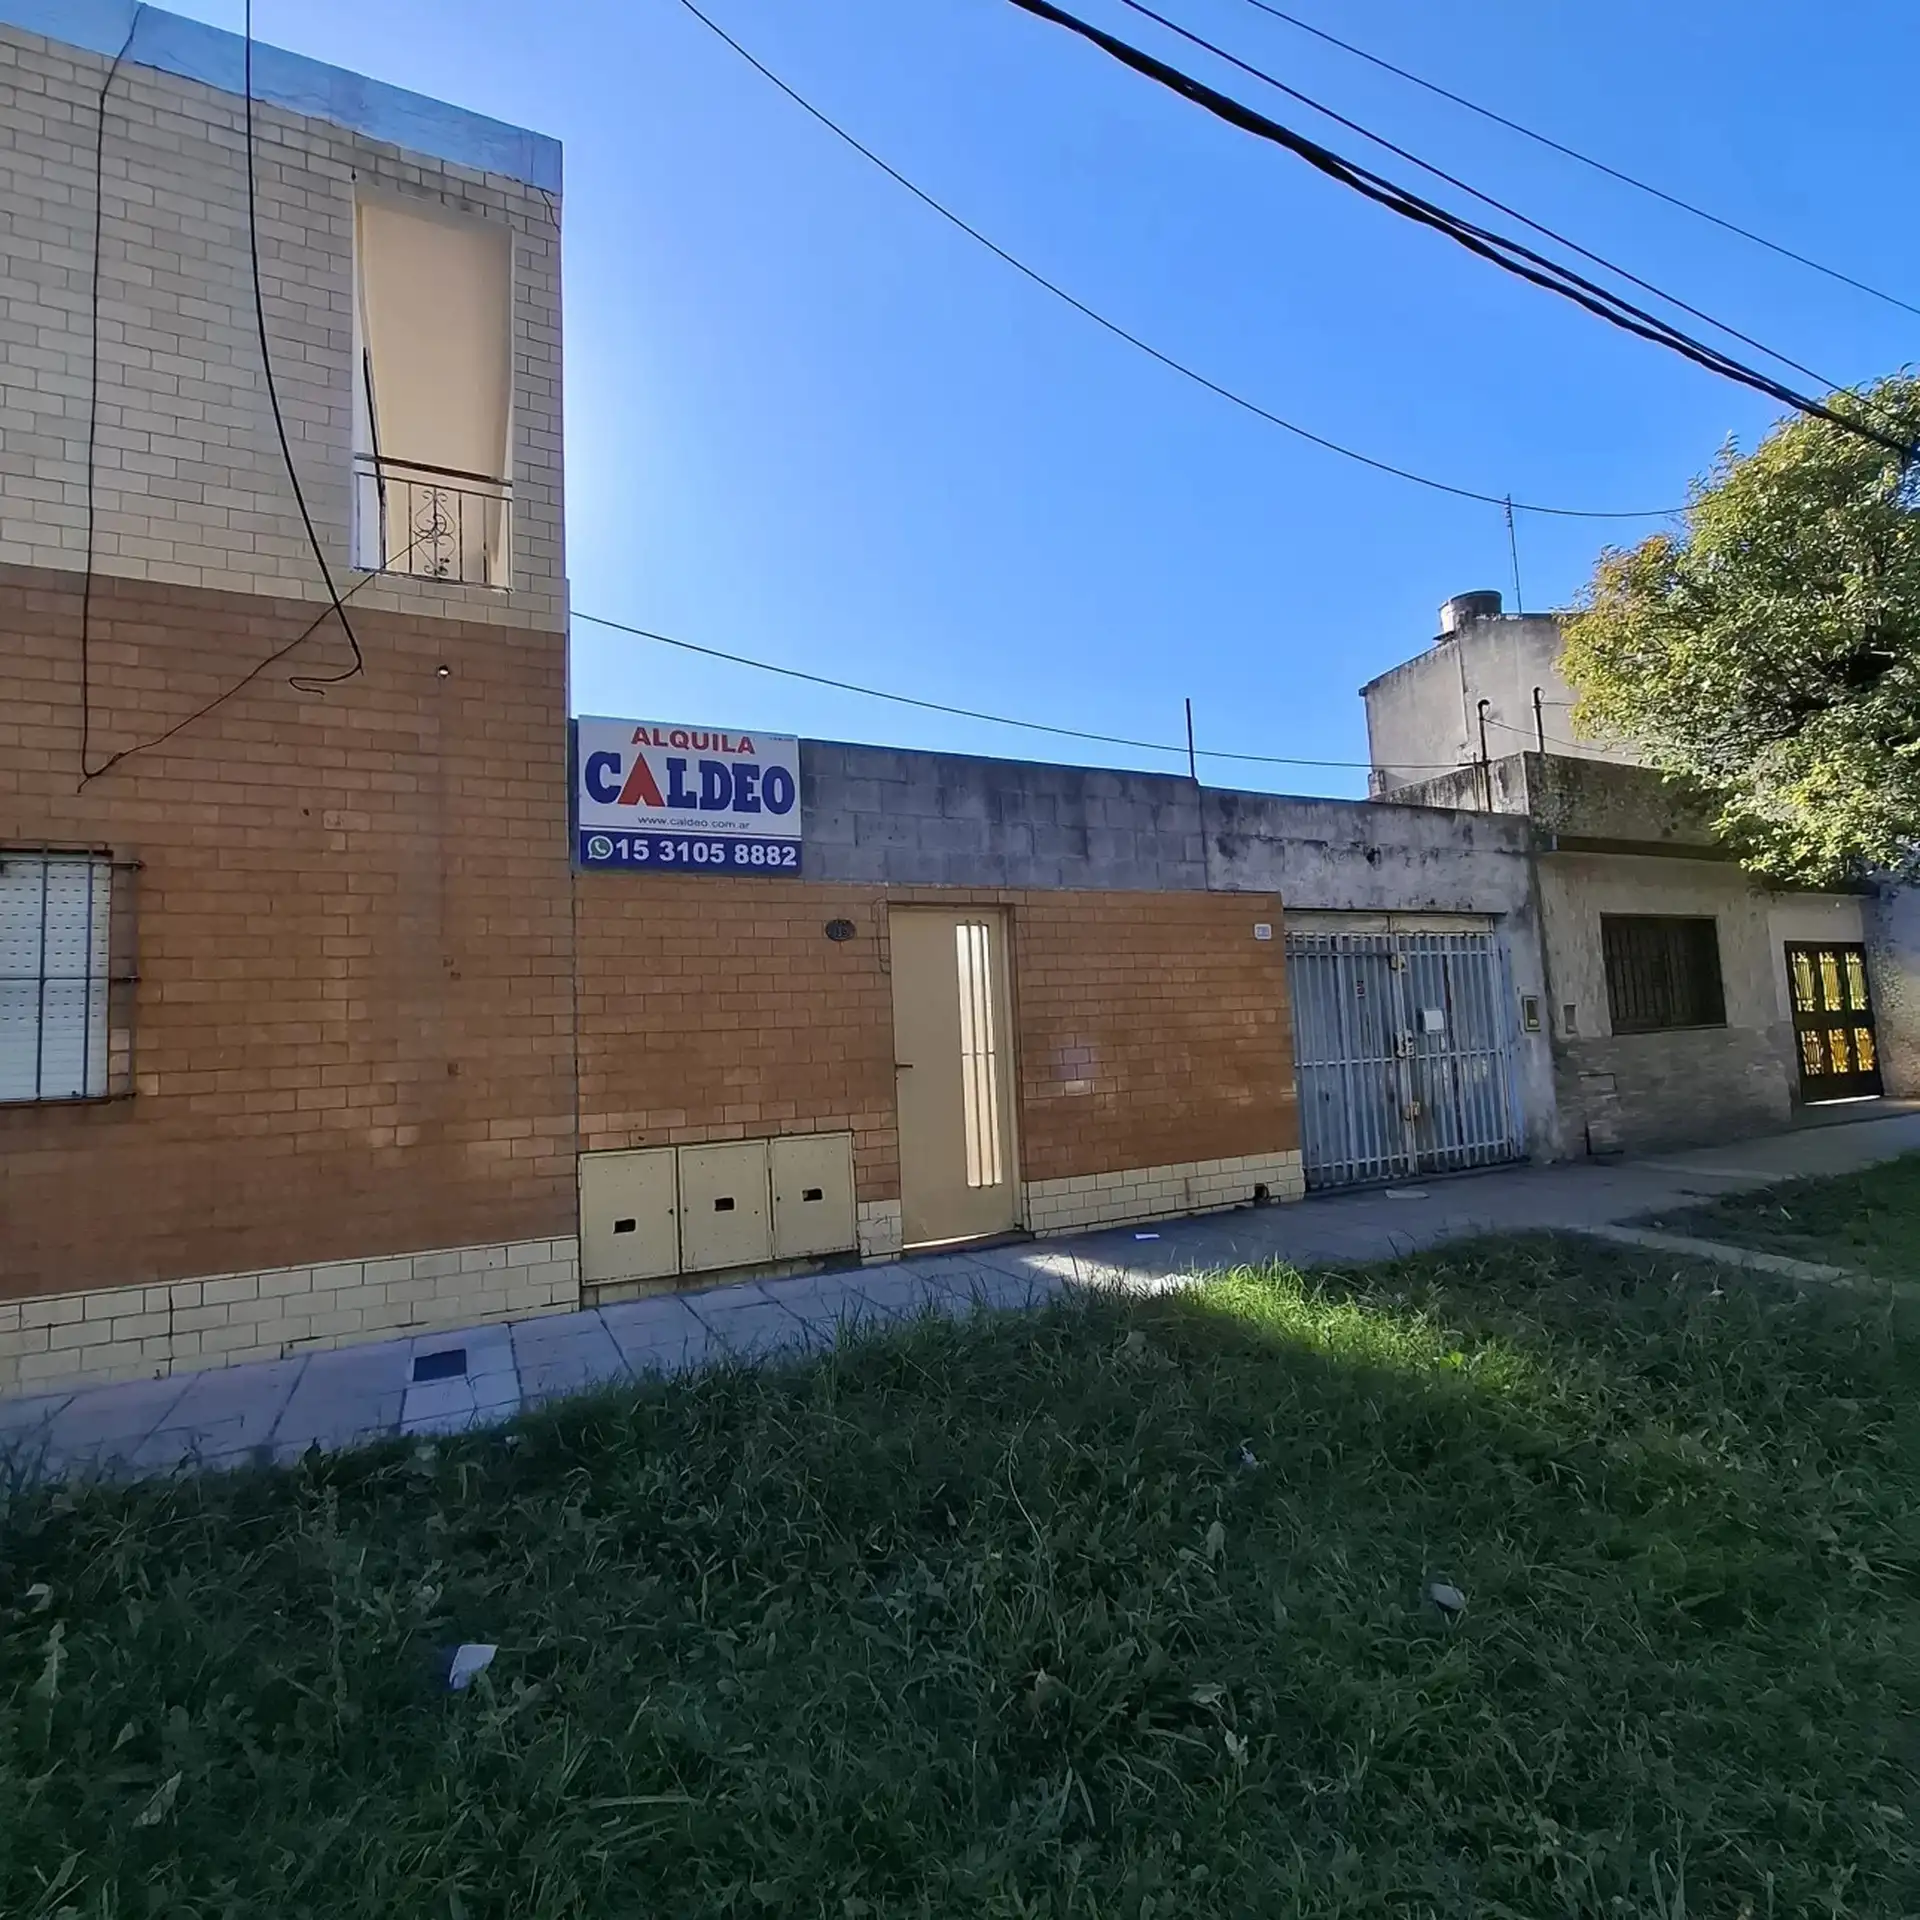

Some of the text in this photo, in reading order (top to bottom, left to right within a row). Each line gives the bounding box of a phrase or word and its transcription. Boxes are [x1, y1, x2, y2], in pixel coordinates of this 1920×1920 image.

[631, 726, 756, 754] ALQUILA
[584, 750, 796, 815] CALDEO
[637, 815, 751, 830] www.caldeo.com.ar
[615, 838, 798, 866] 15 3105 8882
